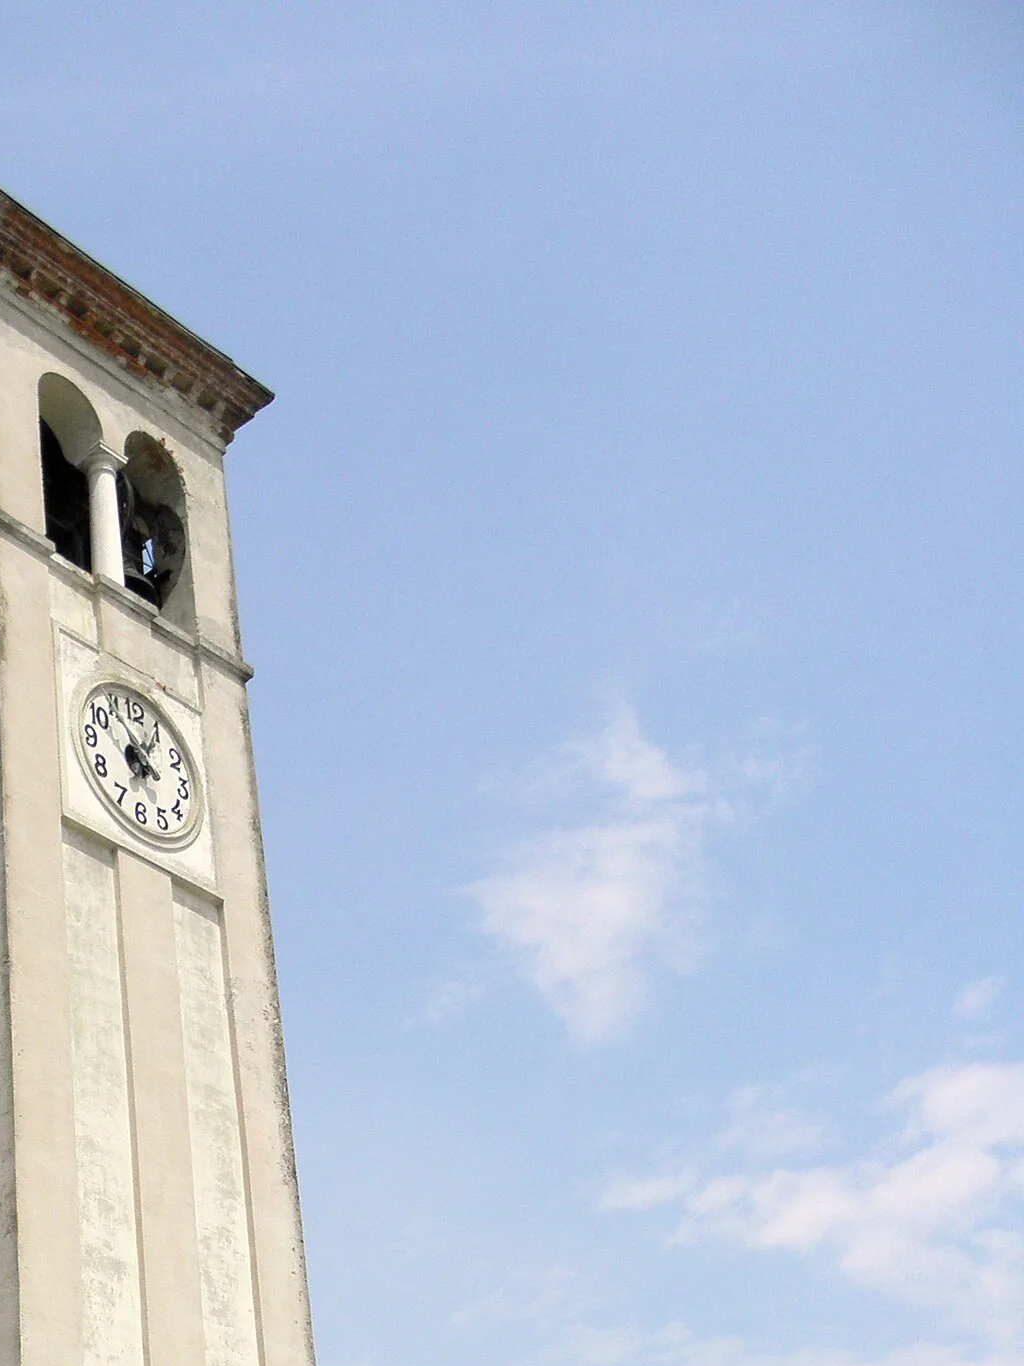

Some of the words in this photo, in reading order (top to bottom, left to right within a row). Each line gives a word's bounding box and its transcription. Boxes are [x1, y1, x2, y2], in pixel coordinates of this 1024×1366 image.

[90, 702, 109, 729] 10
[125, 697, 144, 726] 12
[85, 724, 97, 747] 9
[154, 721, 160, 743] 1
[95, 753, 108, 777] 8
[169, 748, 181, 772] 2
[114, 781, 127, 807] 7
[177, 777, 189, 800] 3
[135, 802, 147, 825] 6
[156, 807, 168, 830] 5
[171, 799, 183, 822] 4
